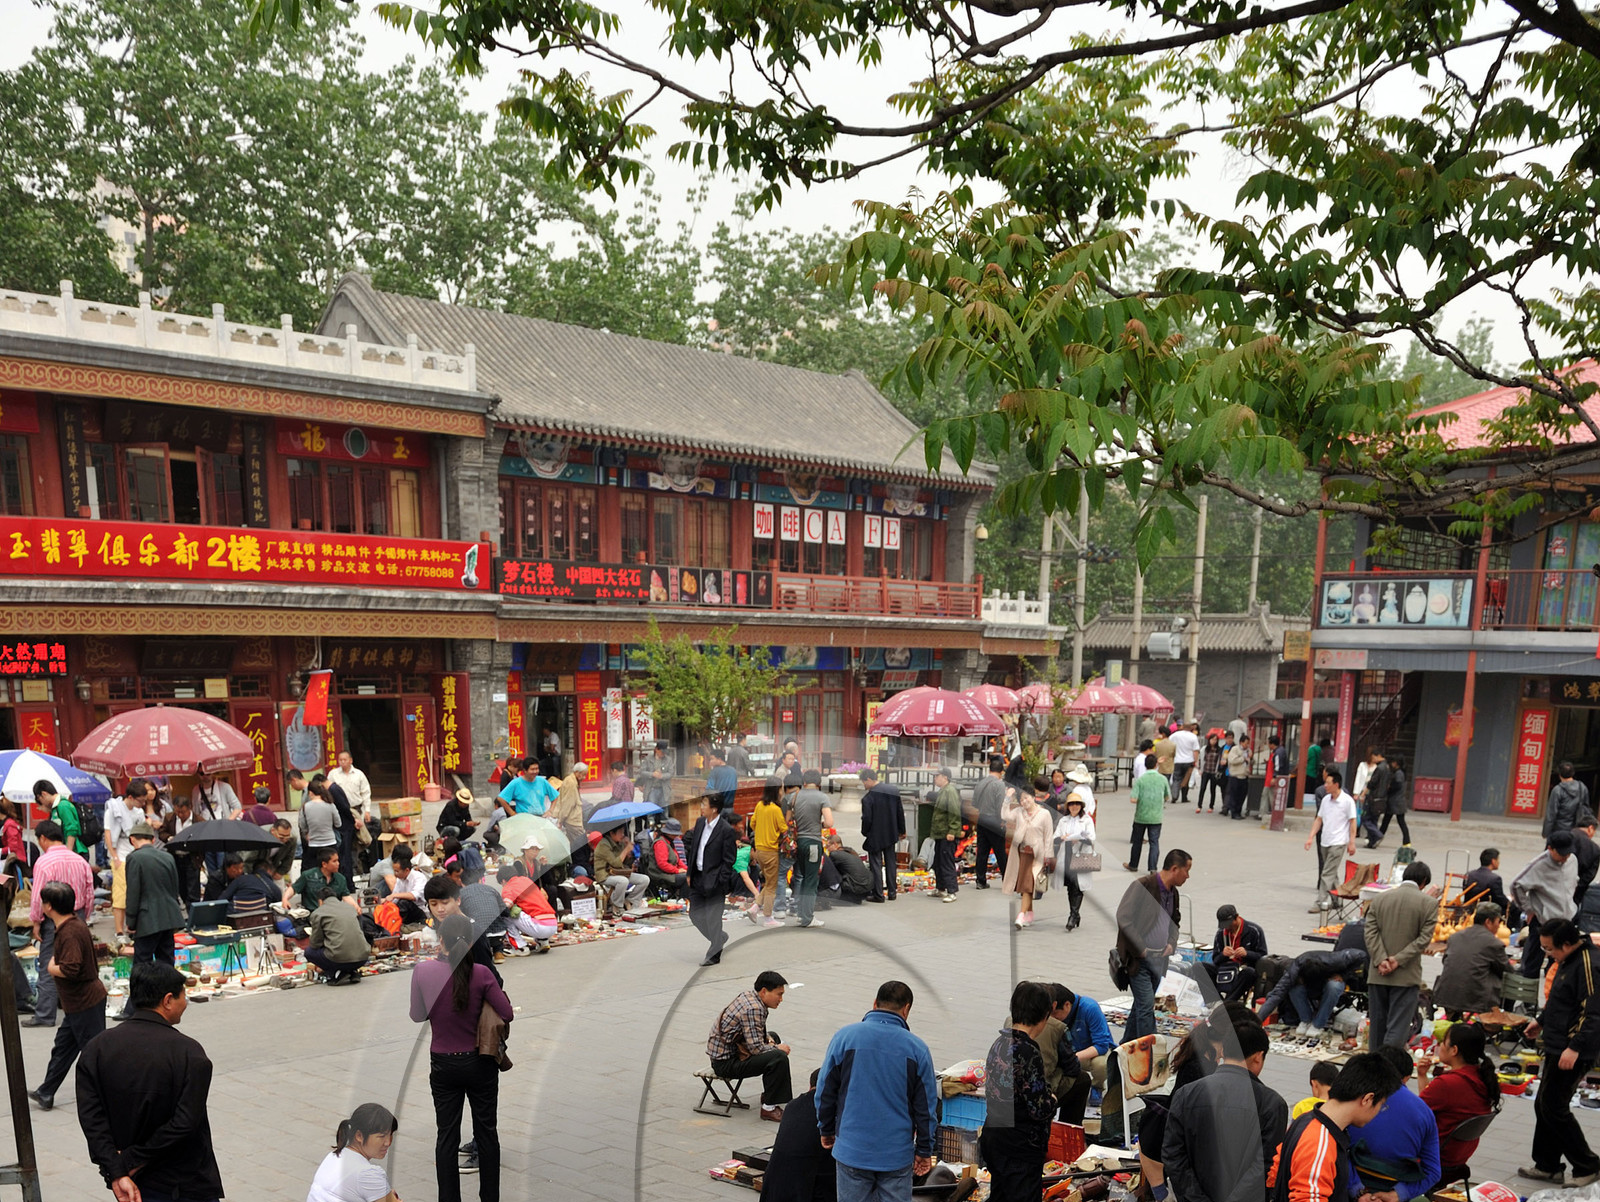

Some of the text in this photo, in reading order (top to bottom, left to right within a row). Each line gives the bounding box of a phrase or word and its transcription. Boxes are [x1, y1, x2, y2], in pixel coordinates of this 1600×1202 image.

[300, 422, 410, 460] 福 玉
[756, 506, 799, 538] 咖啡
[206, 534, 262, 573] 2楼
[265, 540, 316, 556] 厂家直销
[266, 557, 316, 572] 批发零售
[320, 559, 371, 575] 珍品交流
[502, 560, 641, 586] 梦石楼 中国四大名石
[440, 675, 461, 771] 翡翠俱乐部
[582, 700, 599, 780] 青田石
[1514, 712, 1547, 811] 缅甸翡翠
